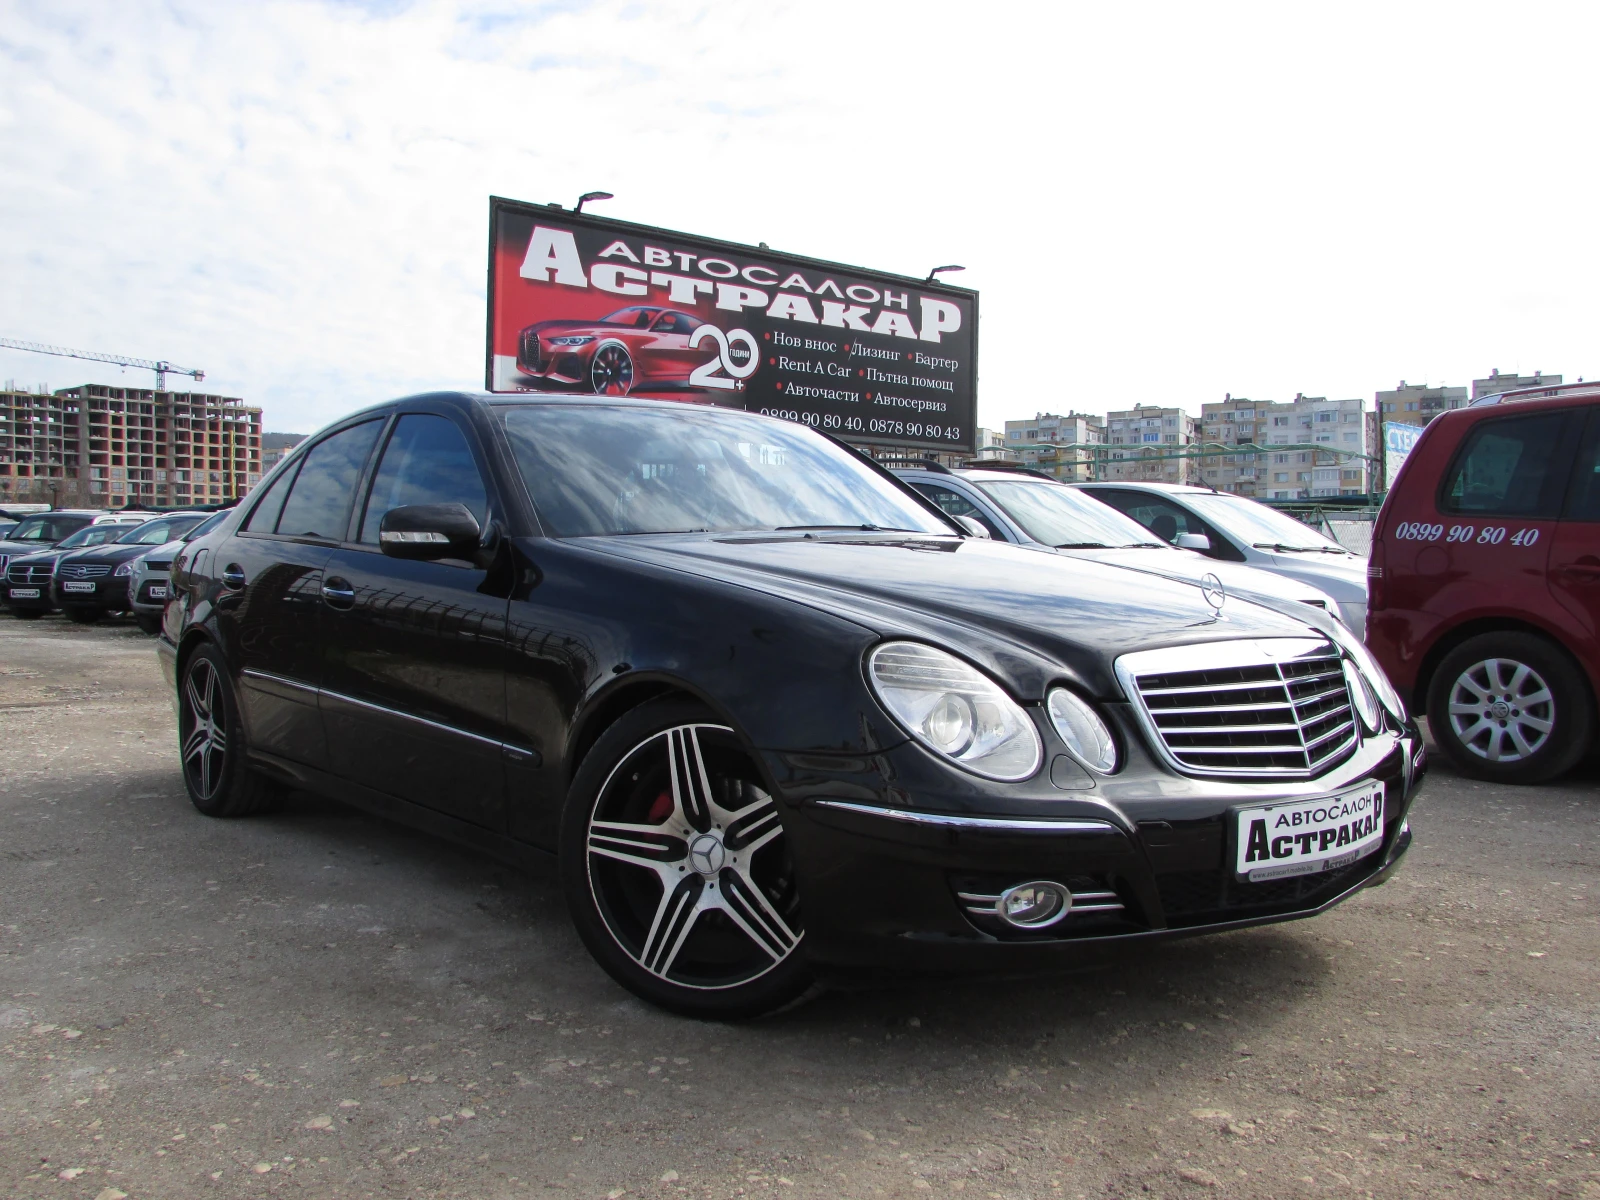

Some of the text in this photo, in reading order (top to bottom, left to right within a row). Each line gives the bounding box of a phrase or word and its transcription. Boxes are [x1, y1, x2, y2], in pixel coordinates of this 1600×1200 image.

[597, 240, 908, 310] АВТОСАЛОН
[729, 348, 750, 359] ГОДИНИ
[773, 331, 959, 373] Нов внос Лизинг Бартер
[778, 356, 852, 378] Rent A Car
[866, 367, 954, 393] Пътна помощ
[784, 381, 947, 413] Авточасти Автосервиз
[801, 412, 820, 427] 90
[823, 414, 841, 429] 80
[844, 416, 866, 433] 40,
[869, 418, 903, 434] 0878
[906, 422, 923, 436] 90
[925, 424, 942, 438] 80
[944, 426, 960, 440] 43
[1395, 522, 1539, 547] 0899 90 80 40
[1274, 793, 1372, 829] АВТОСАЛОН
[1244, 791, 1382, 863] АСТРАКАР
